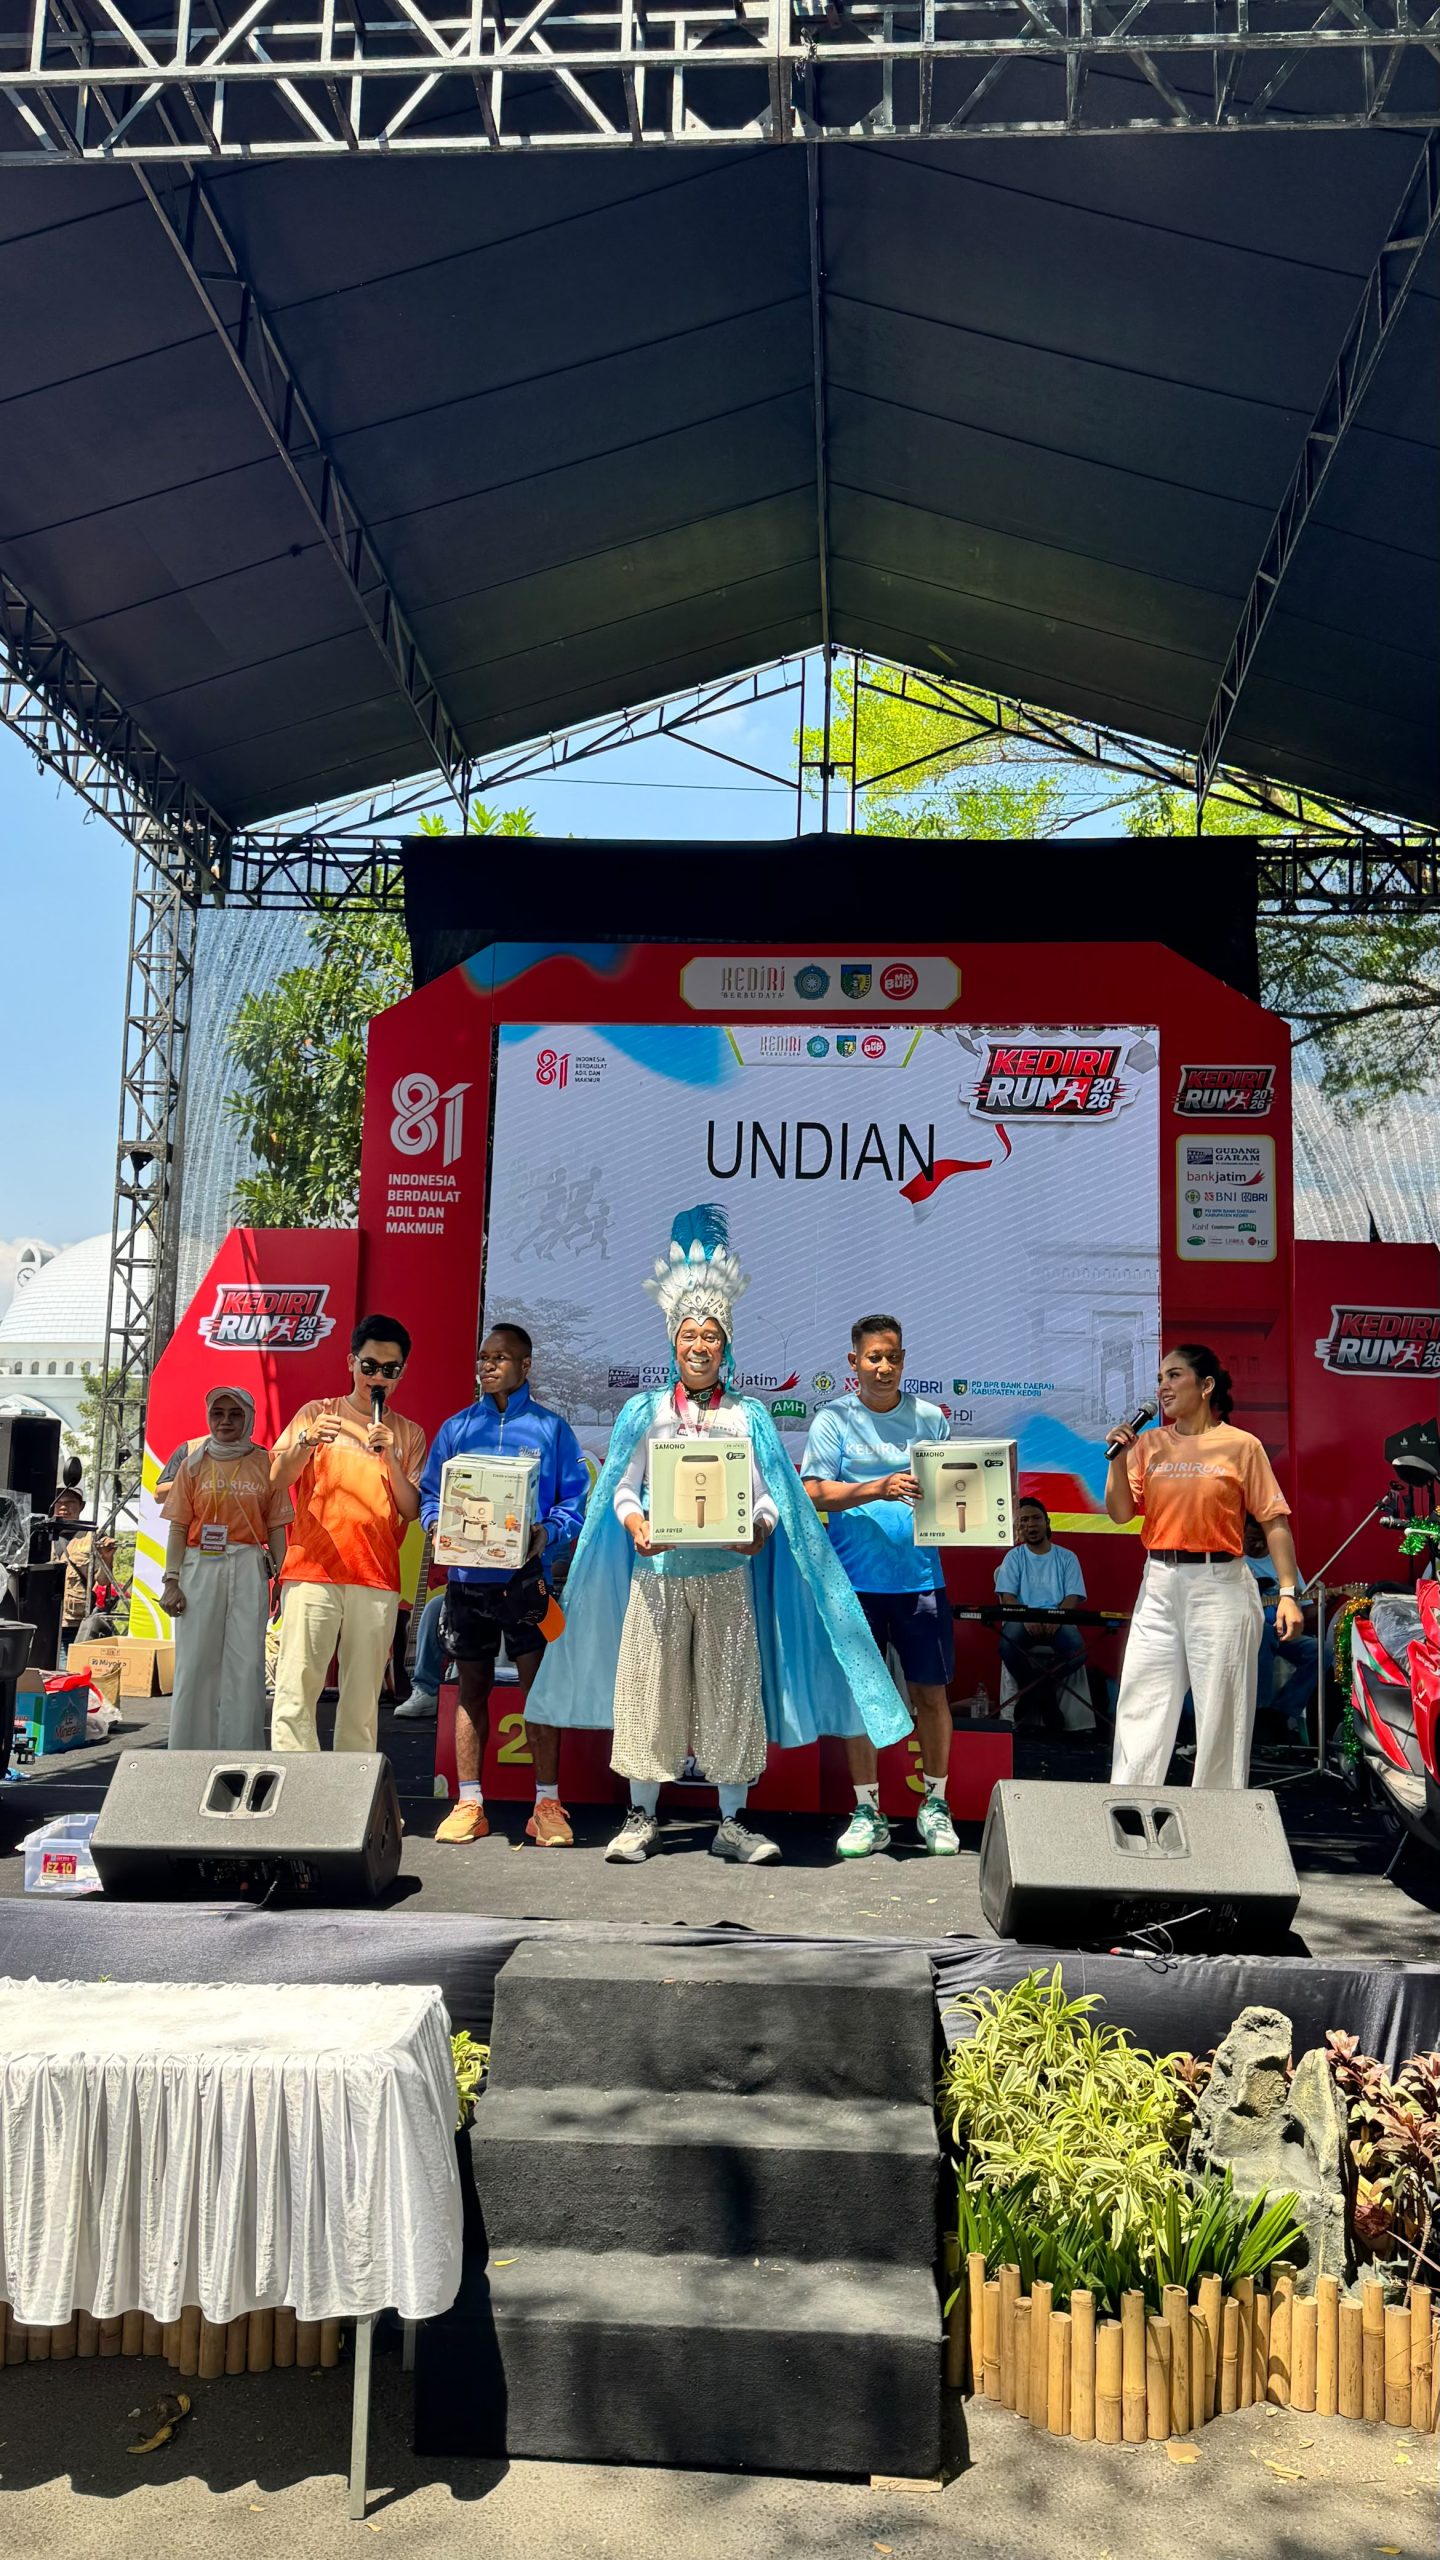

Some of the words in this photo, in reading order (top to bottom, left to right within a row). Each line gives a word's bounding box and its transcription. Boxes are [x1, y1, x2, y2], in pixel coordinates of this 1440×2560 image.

[990, 1049, 1114, 1076] KEDIRI
[1187, 1070, 1267, 1089] KEDIRI
[985, 1077, 1068, 1107] RUN
[1090, 1078, 1116, 1093] 20
[1184, 1088, 1237, 1109] RUN
[1252, 1089, 1268, 1100] 20
[1086, 1094, 1111, 1109] 26
[1249, 1100, 1266, 1110] 26
[390, 1072, 474, 1168] 81
[706, 1119, 935, 1182] UNDIAN
[1215, 1147, 1260, 1155] GUDANG
[1215, 1154, 1260, 1162] GARAM
[388, 1173, 457, 1187] INDONESIA
[1186, 1170, 1247, 1184] bankjatim
[387, 1189, 462, 1203] BERDAULAT
[1215, 1191, 1237, 1202] BNI
[1251, 1192, 1268, 1202] BRI
[386, 1205, 416, 1218] ADIL
[418, 1206, 445, 1219] DAN
[385, 1221, 445, 1235] MAKMUR
[222, 1291, 319, 1315] KEDIRI
[216, 1315, 279, 1340] RUN
[299, 1316, 318, 1329] 20
[295, 1329, 314, 1341] 26
[1336, 1338, 1406, 1365] RUN
[919, 1380, 943, 1394] BRI
[971, 1380, 982, 1388] PD
[983, 1381, 999, 1389] BPR
[1000, 1381, 1022, 1390] BANK
[1023, 1382, 1055, 1391] DAERAH
[971, 1388, 1015, 1396] KABUPATEN
[1016, 1389, 1042, 1397] KEDIRI
[773, 1401, 805, 1414] AMH
[953, 1409, 973, 1421] HDI
[497, 1713, 534, 1764] 2
[46, 1861, 59, 1873] EZ
[61, 1862, 73, 1874] 10
